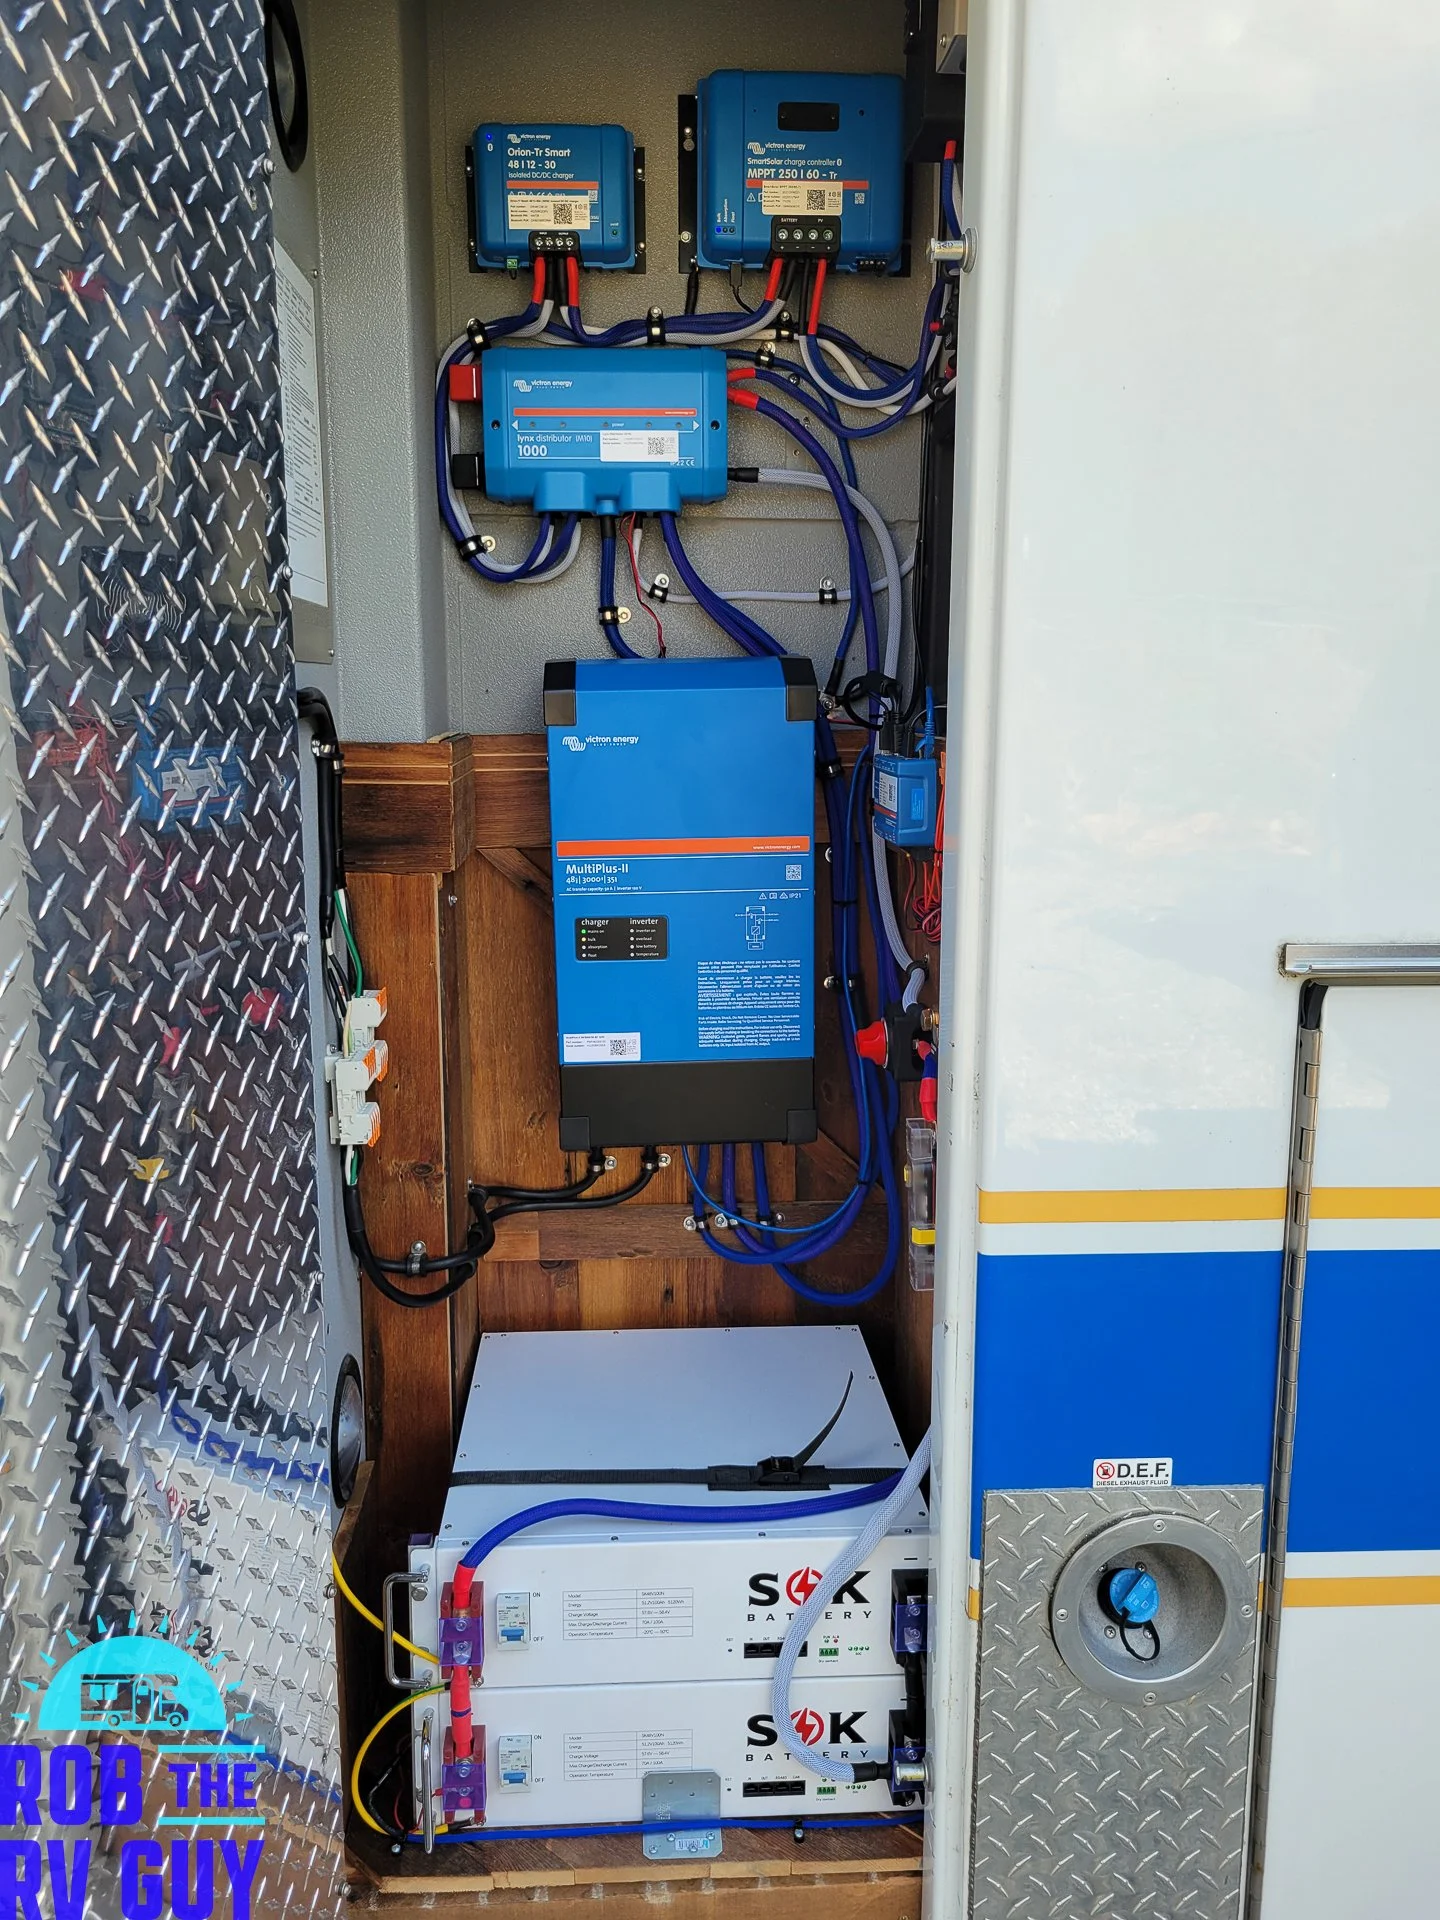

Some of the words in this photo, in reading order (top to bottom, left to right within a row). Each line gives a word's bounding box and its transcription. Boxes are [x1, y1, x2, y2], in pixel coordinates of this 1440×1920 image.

[508, 148, 542, 156] Orion-Tr
[545, 148, 571, 157] Smart
[508, 160, 519, 168] 48
[526, 160, 535, 168] 12
[545, 160, 556, 169] 30
[552, 172, 574, 180] charger
[748, 169, 776, 178] MPPT
[778, 169, 797, 178] 250
[806, 169, 819, 179] 60
[518, 434, 534, 443] lynx
[536, 434, 572, 442] distributor
[518, 445, 547, 456] 1000
[612, 736, 639, 744] energy
[566, 863, 628, 874] MultiPlus-II
[581, 918, 609, 927] charger
[1118, 1463, 1169, 1478] D.E.F.
[748, 1611, 872, 1621] BATERY
[747, 1707, 868, 1747] SOK
[746, 1750, 869, 1761] BATERY
